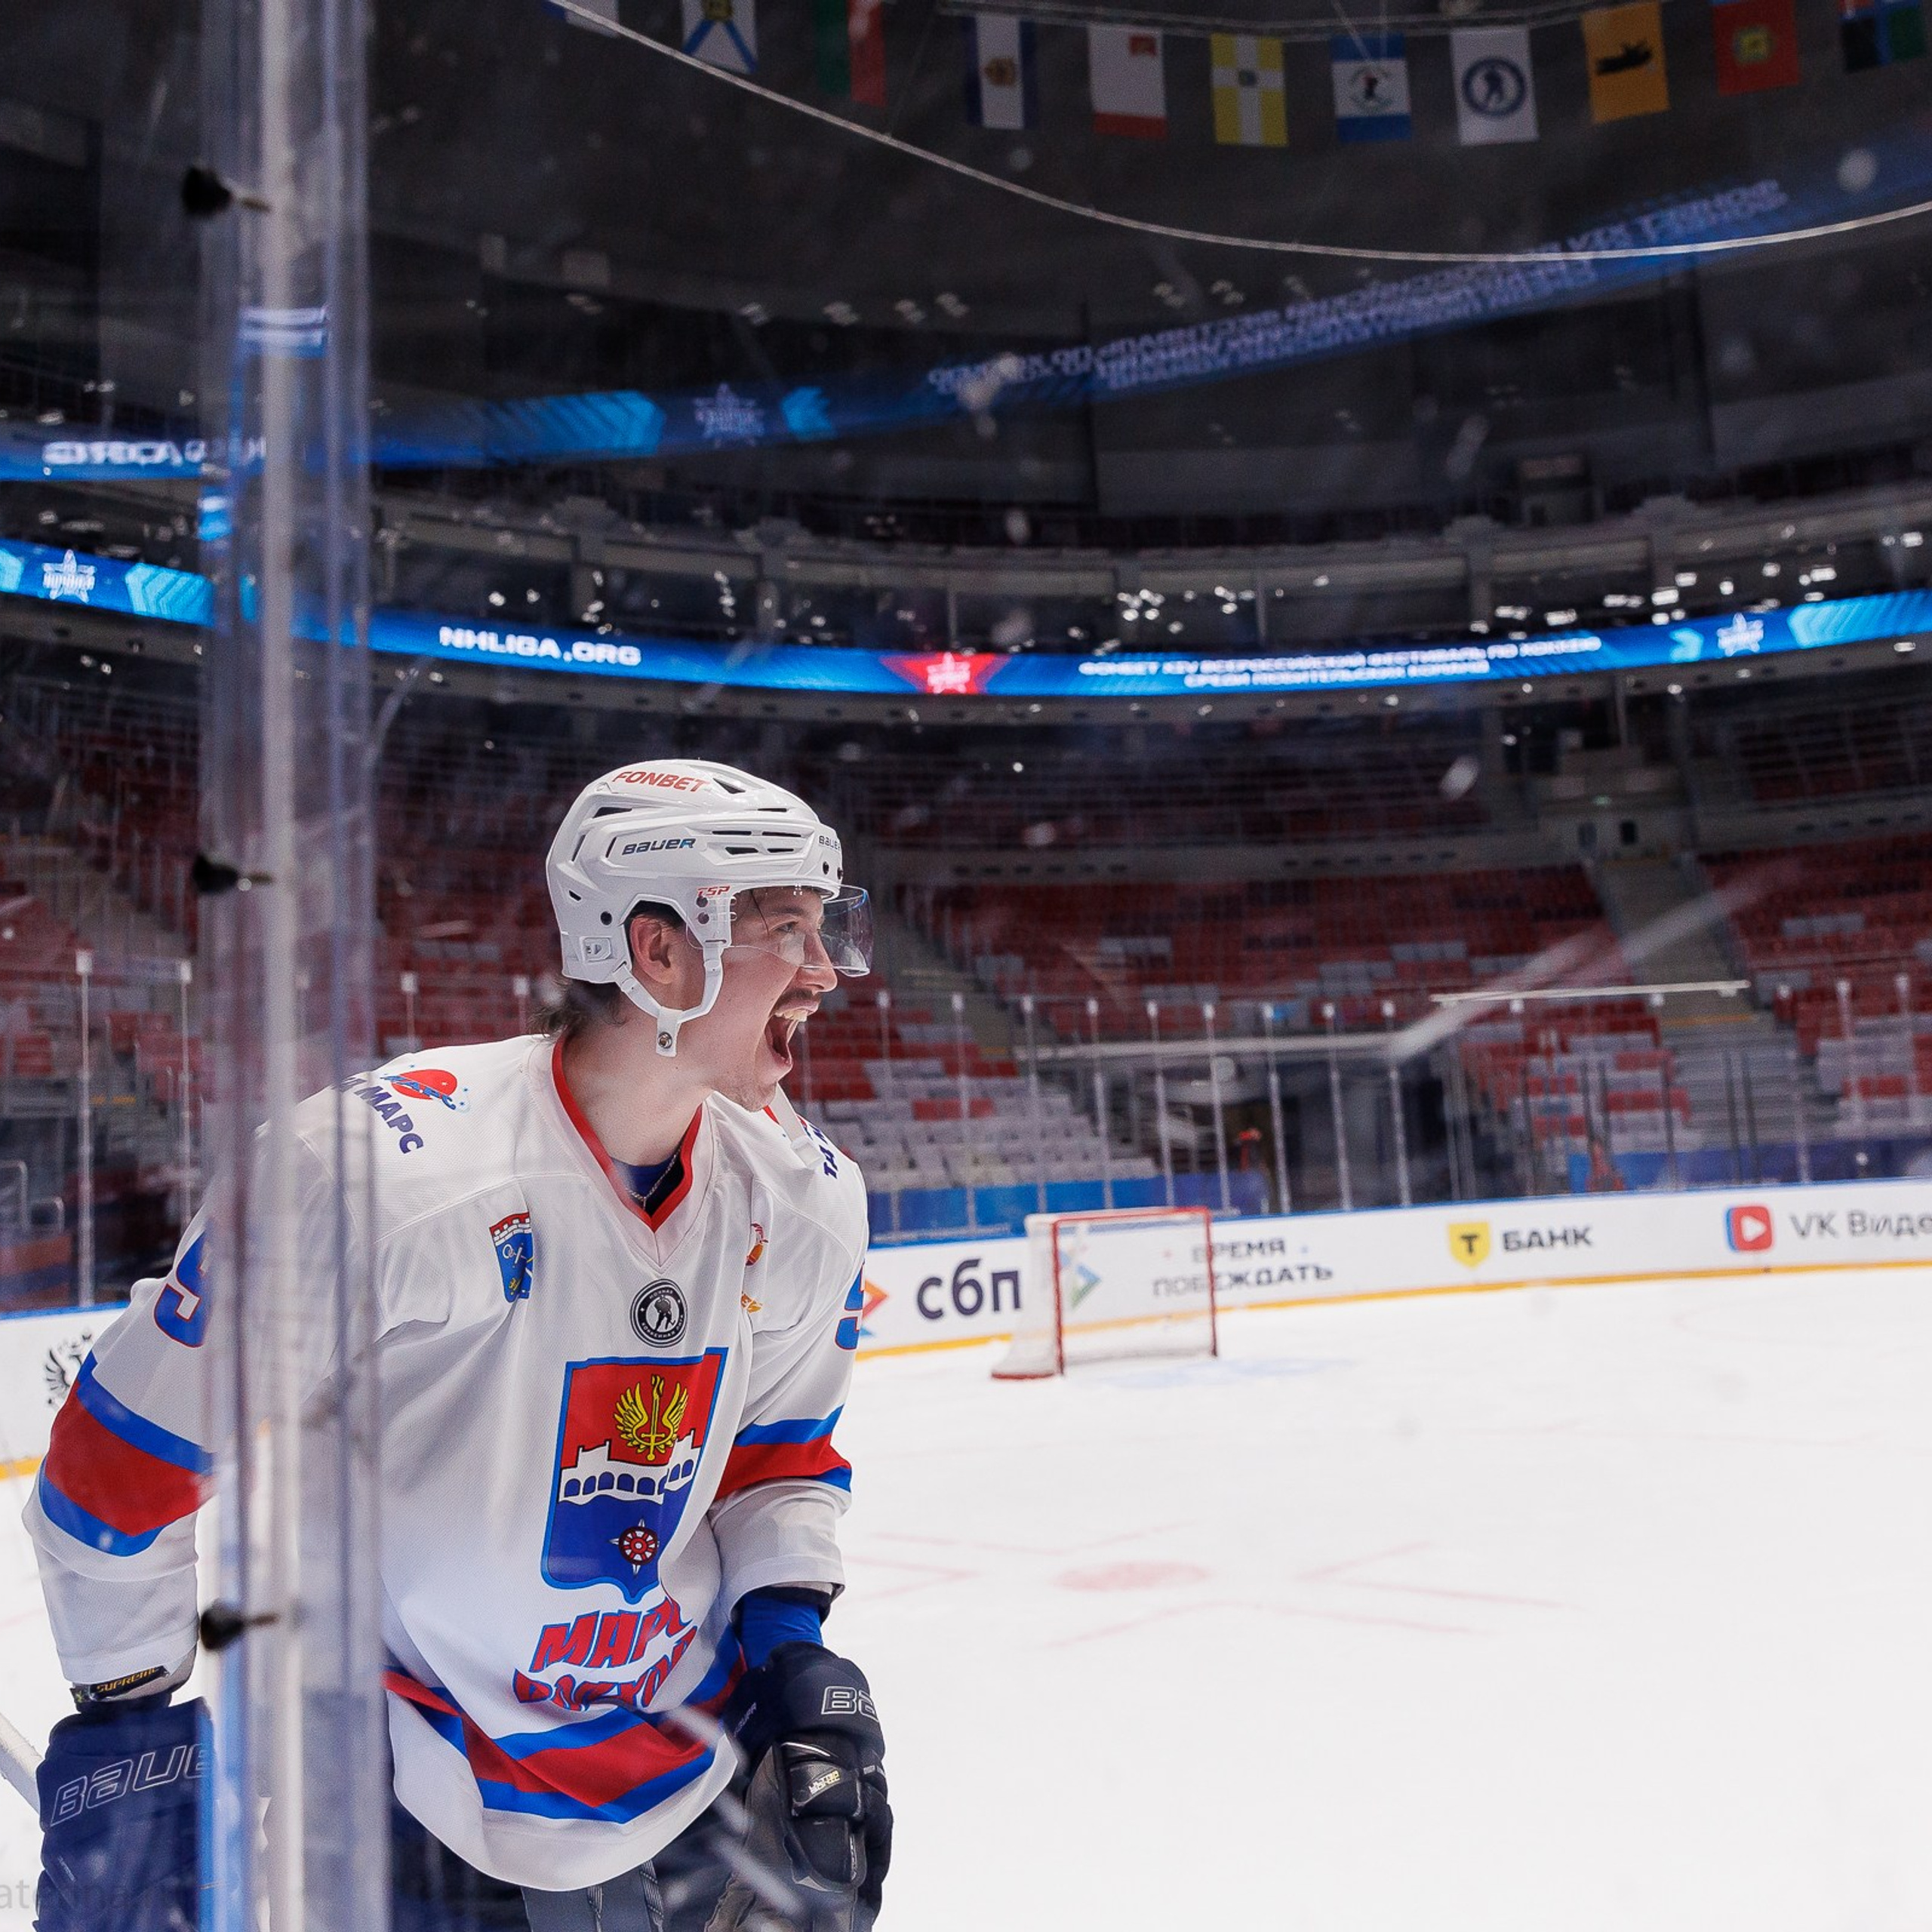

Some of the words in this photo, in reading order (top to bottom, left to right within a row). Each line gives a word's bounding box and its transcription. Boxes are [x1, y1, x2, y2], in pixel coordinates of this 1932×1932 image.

[438, 626, 641, 666] NHLIGA.ORG
[612, 771, 709, 792] FONBET
[353, 1085, 424, 1154] МАРС
[1789, 1211, 1838, 1239] VK
[1503, 1227, 1592, 1252] БАНК
